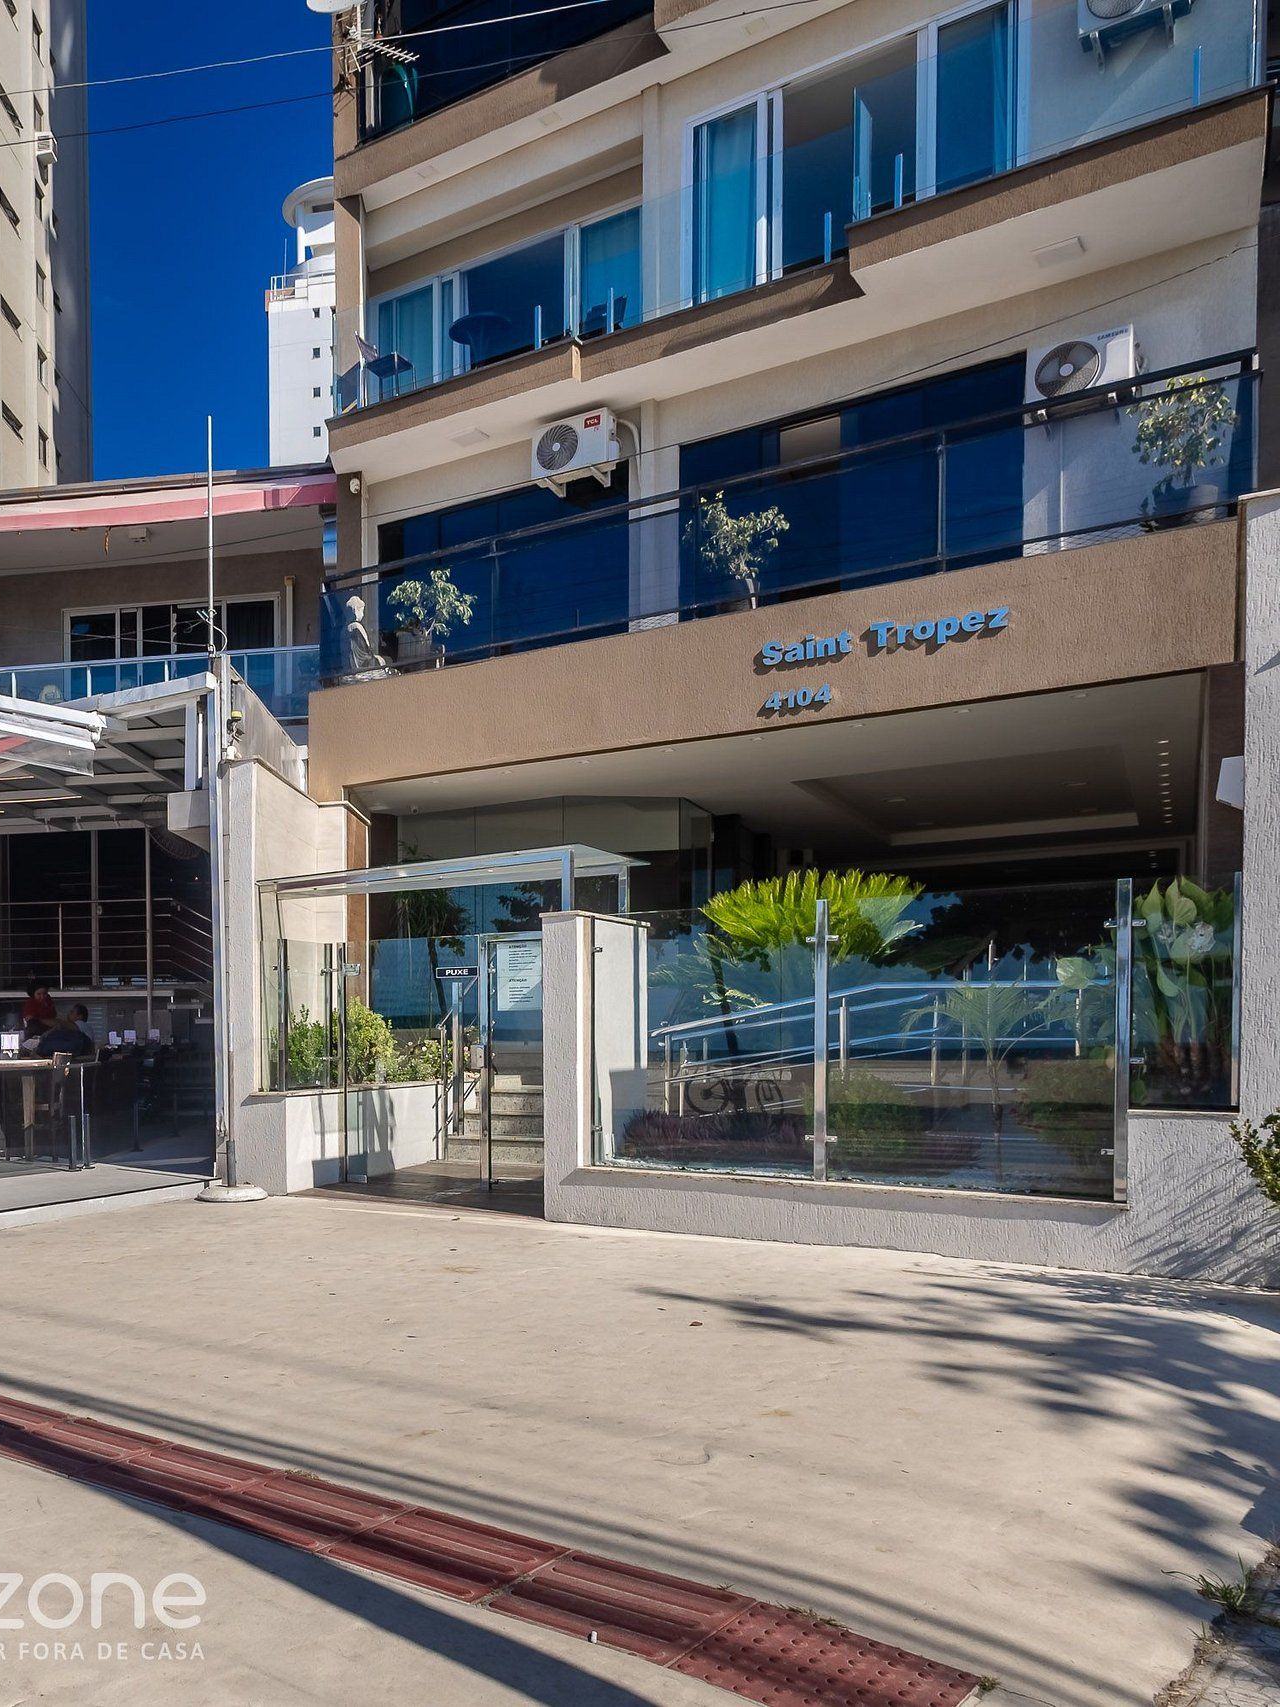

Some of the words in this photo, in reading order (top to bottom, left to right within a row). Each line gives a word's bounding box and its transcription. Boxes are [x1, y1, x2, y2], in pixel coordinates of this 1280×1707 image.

[762, 630, 853, 666] Saint
[870, 606, 1010, 647] Tropez
[765, 682, 831, 710] 4104
